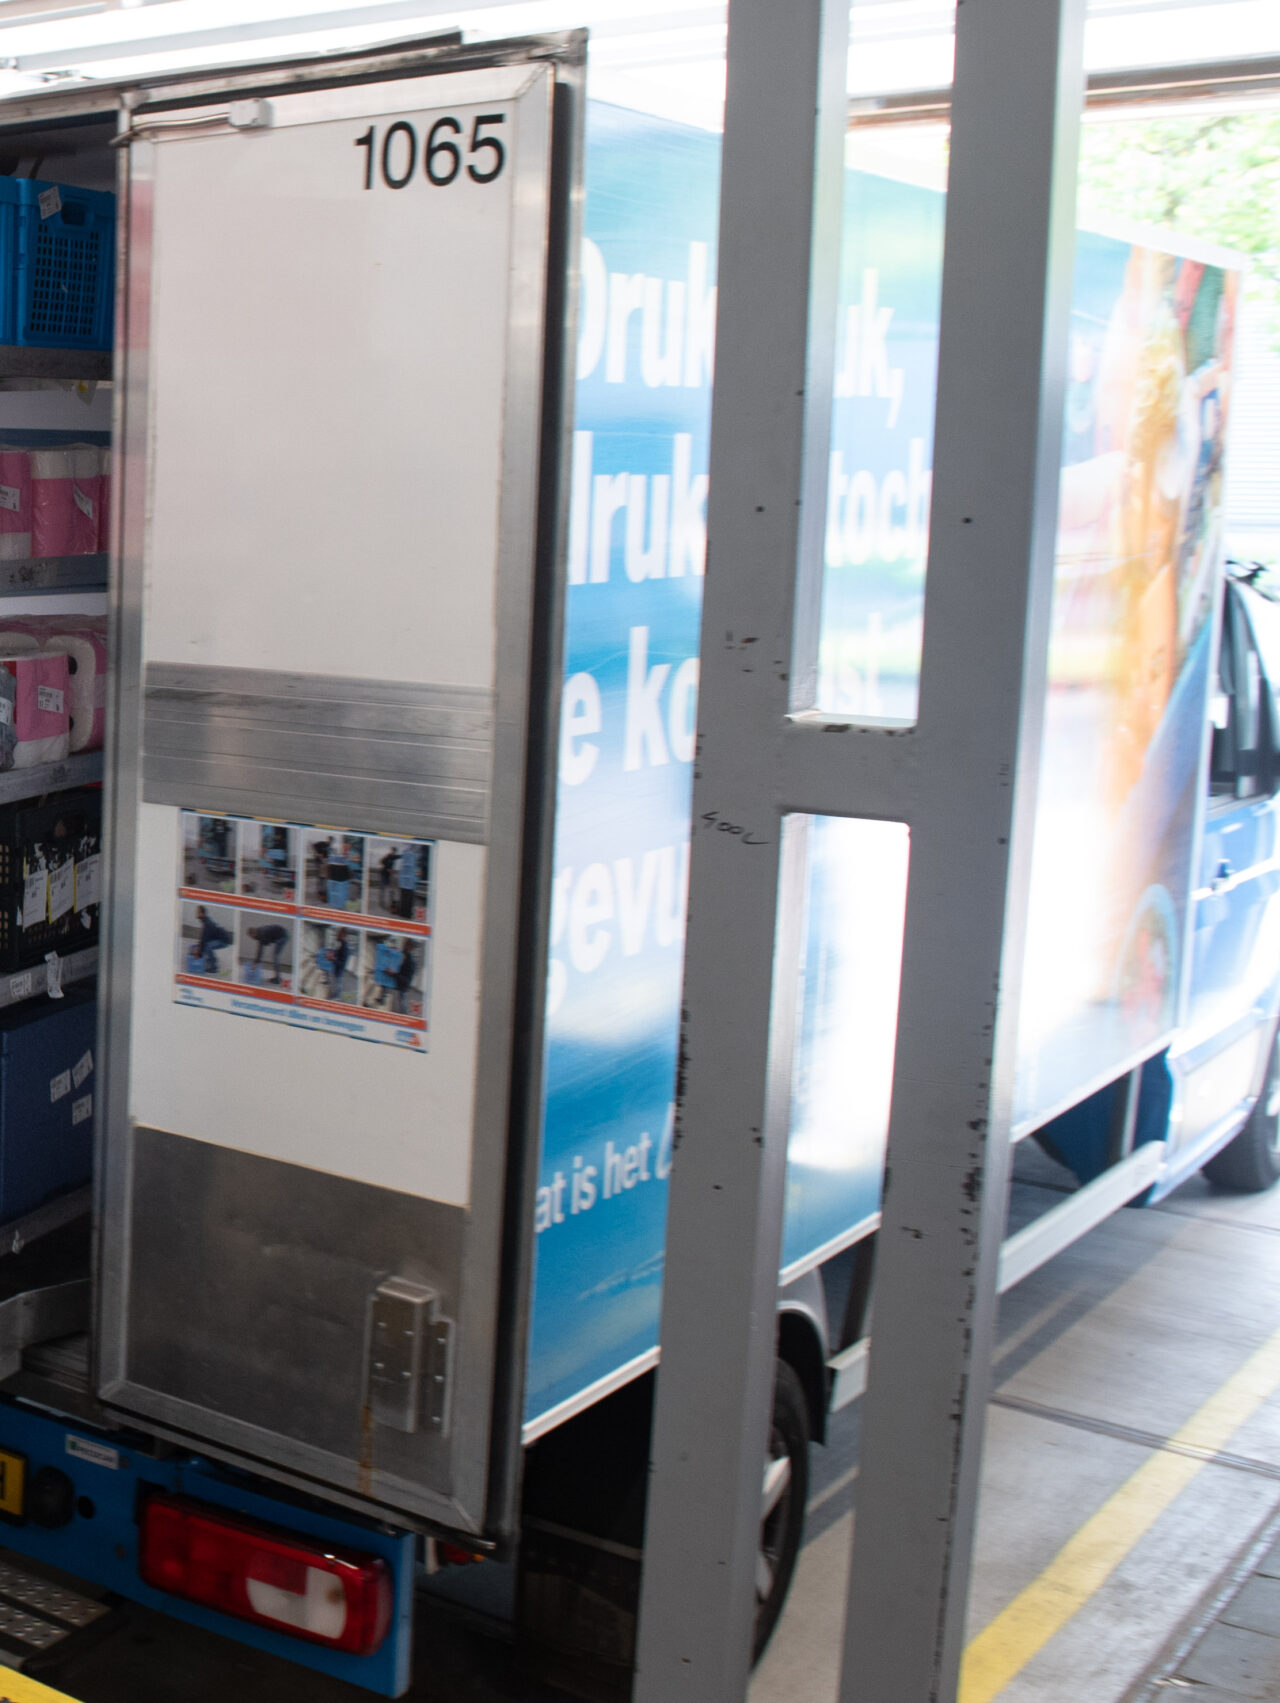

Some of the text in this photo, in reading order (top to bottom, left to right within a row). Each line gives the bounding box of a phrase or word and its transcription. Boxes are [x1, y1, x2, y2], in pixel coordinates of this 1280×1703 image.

[354, 113, 506, 190] 1065
[571, 1155, 598, 1215] is
[603, 1132, 652, 1200] het
